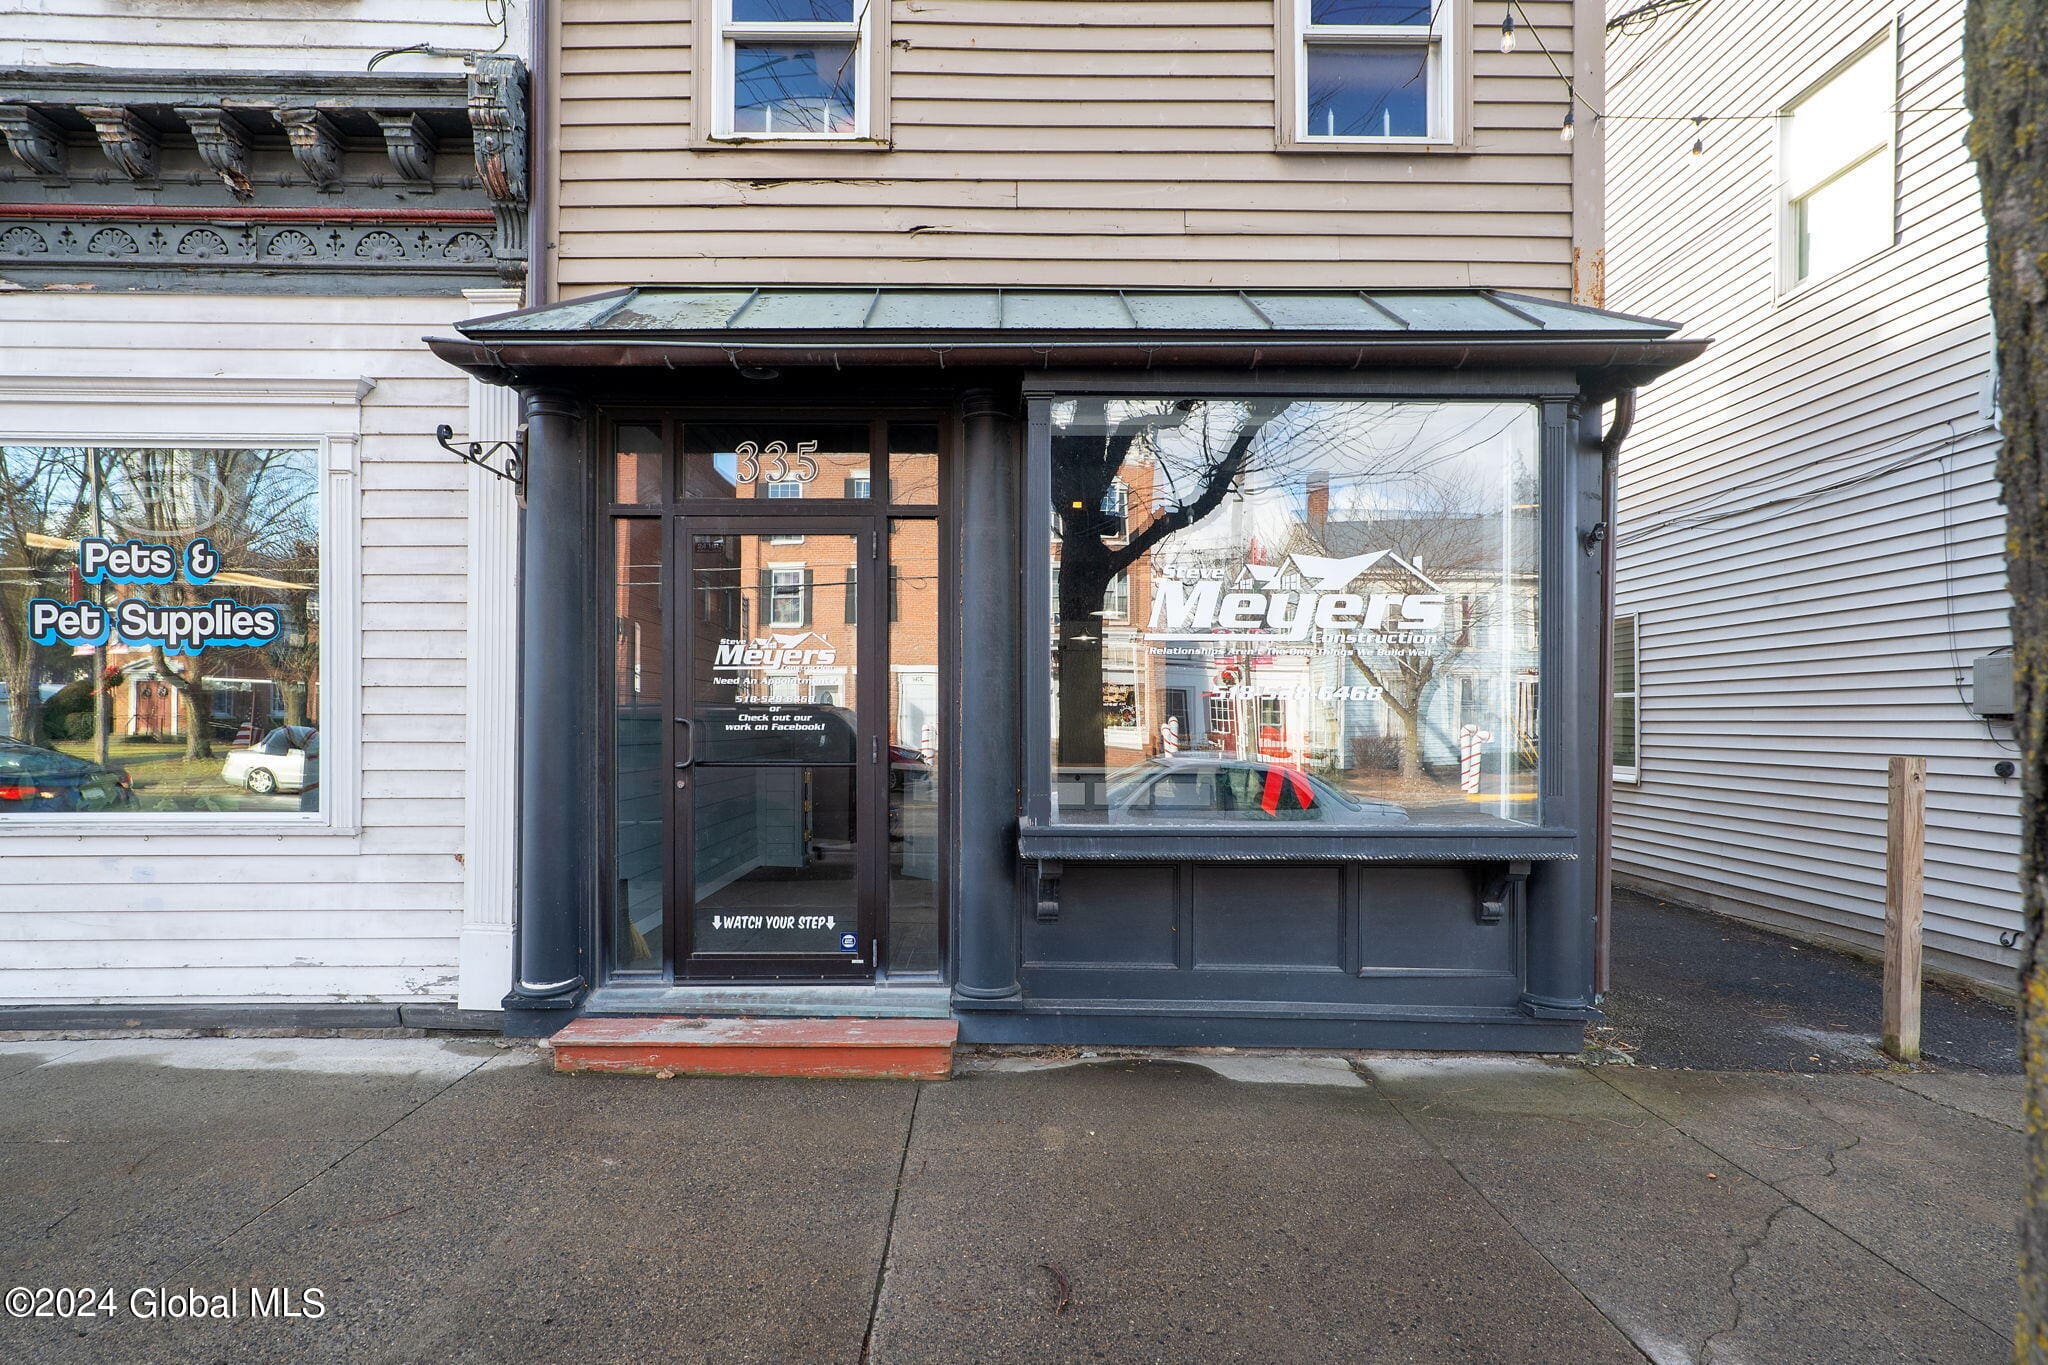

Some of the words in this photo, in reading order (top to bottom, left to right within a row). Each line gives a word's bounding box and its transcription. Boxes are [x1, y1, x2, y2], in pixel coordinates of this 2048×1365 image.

[735, 440, 819, 483] 335
[82, 541, 175, 578] Pets
[188, 541, 217, 577] &
[1163, 565, 1225, 579] Steve
[1146, 581, 1447, 641] Meyers
[32, 602, 103, 638] Pet
[119, 602, 278, 647] Supplies
[1311, 631, 1437, 644] Construction
[714, 645, 837, 670] Meyers
[1149, 647, 1225, 656] Relationships
[1315, 648, 1353, 656] Things
[1357, 648, 1375, 656] We
[1377, 648, 1404, 656] Build
[1408, 648, 1431, 656] Well
[713, 677, 738, 685] Need
[743, 677, 757, 685] An
[738, 714, 769, 722] Check
[725, 723, 751, 731] work
[771, 723, 825, 731] Facebook!
[723, 915, 763, 930] WATCH
[766, 915, 794, 929] YOUR
[797, 915, 826, 929] STEP
